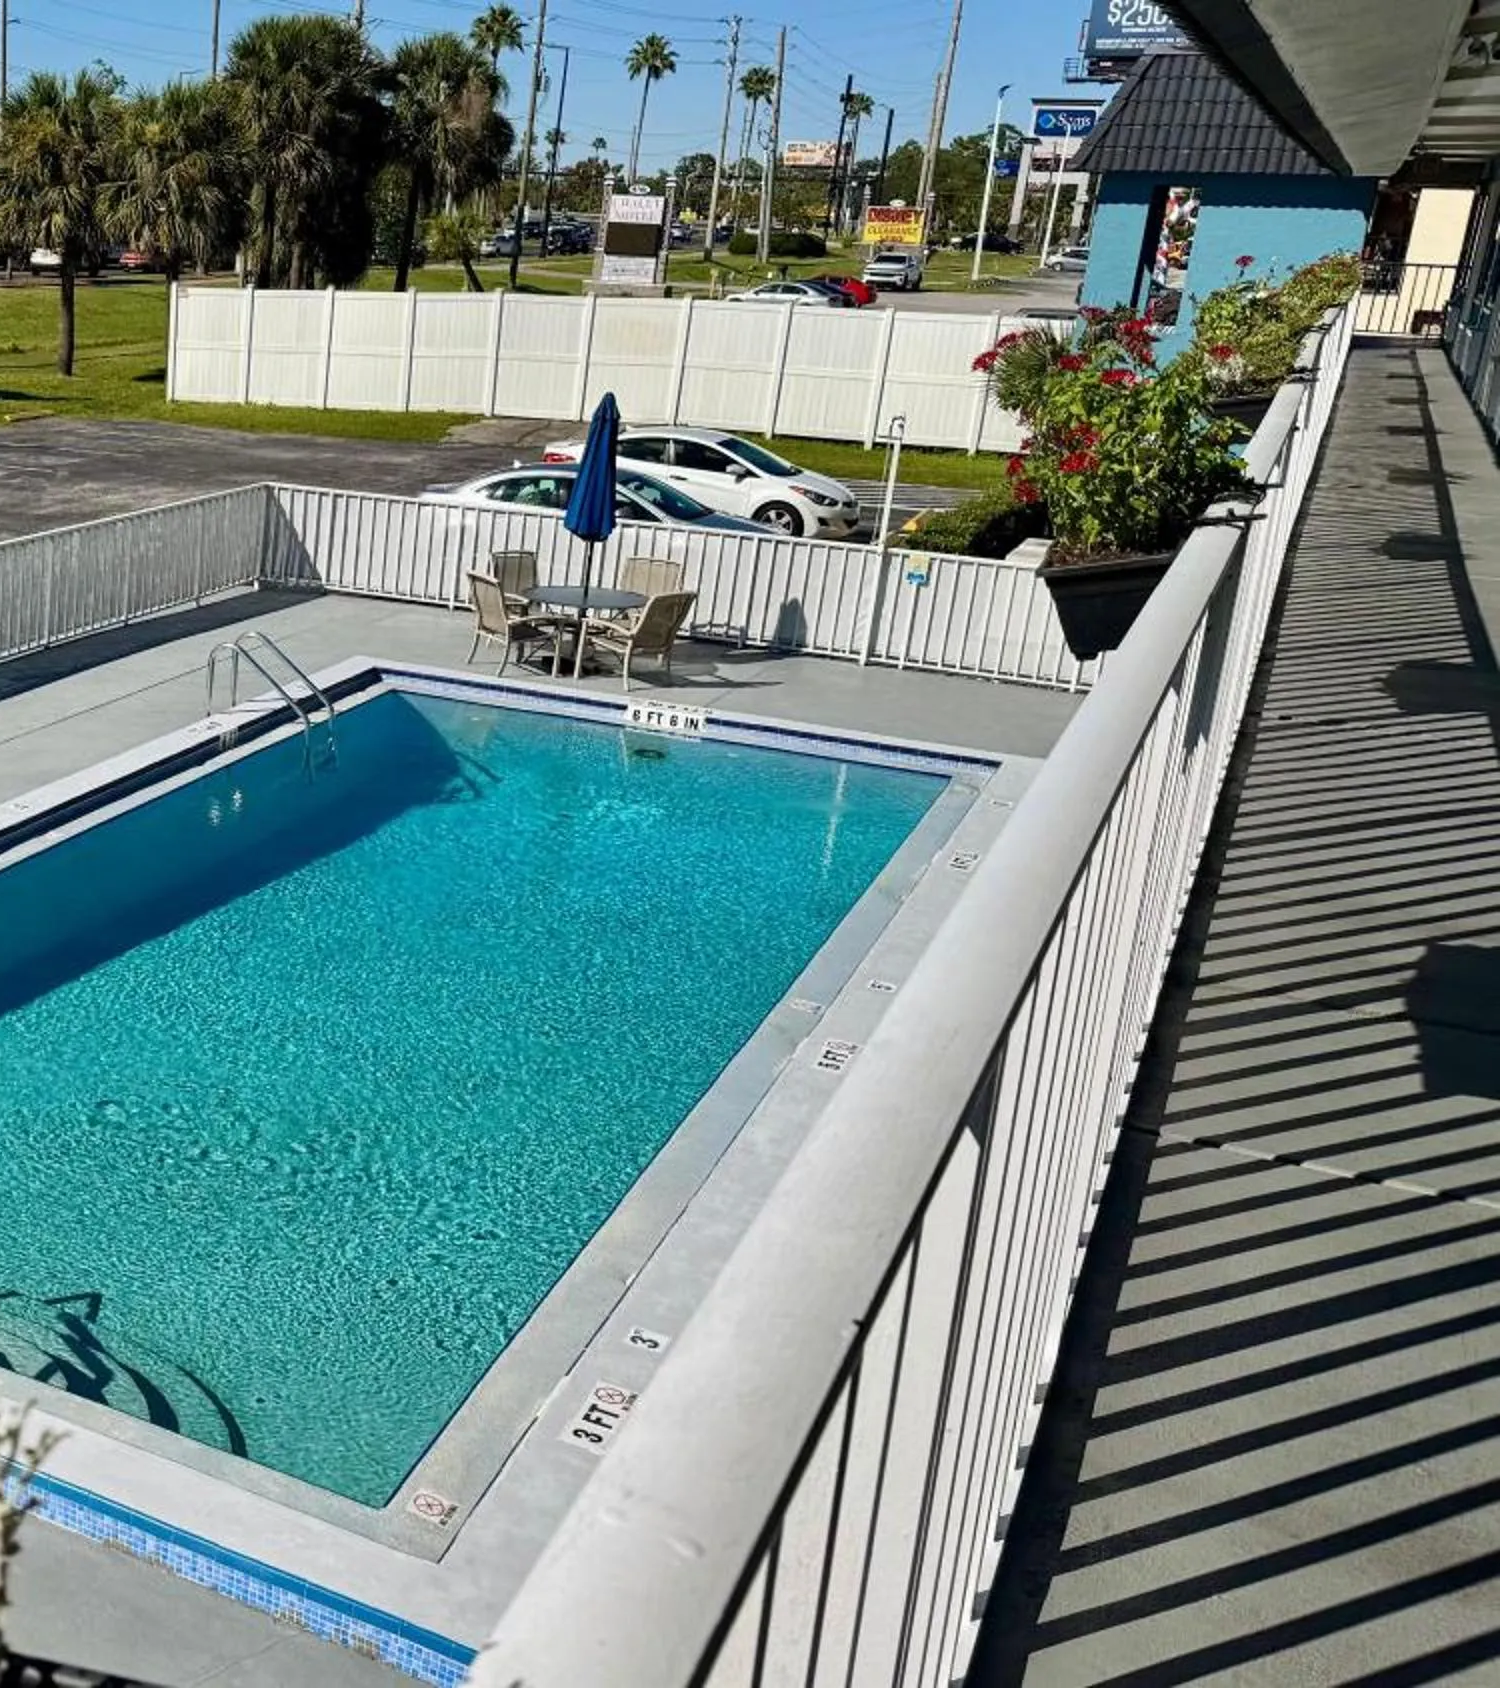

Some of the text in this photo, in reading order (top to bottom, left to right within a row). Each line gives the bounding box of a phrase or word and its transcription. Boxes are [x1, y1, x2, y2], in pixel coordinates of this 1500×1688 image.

[647, 711, 663, 725] FT
[684, 716, 700, 731] IN
[572, 1403, 621, 1444] 3 FT
